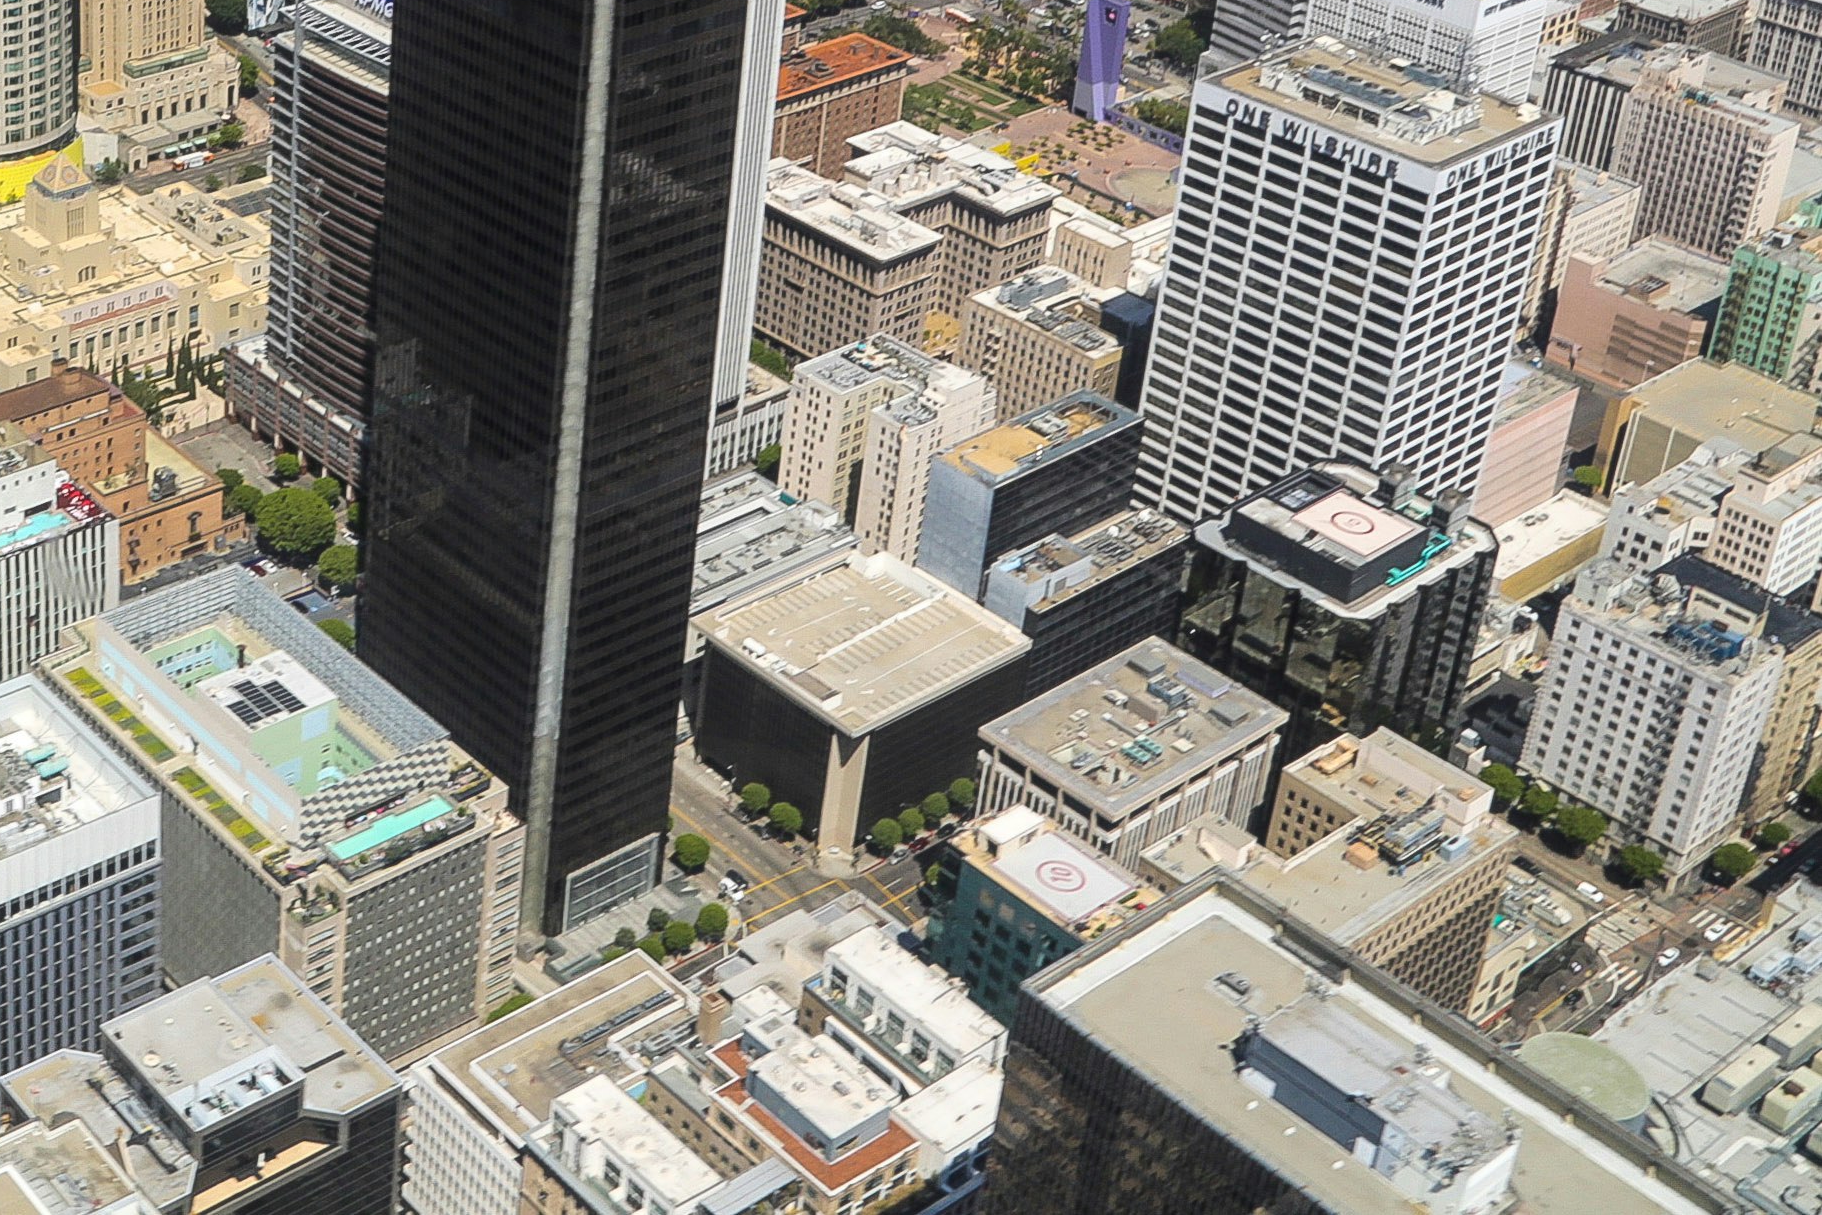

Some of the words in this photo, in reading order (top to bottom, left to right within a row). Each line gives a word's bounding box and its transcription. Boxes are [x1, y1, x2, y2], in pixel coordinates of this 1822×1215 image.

[1226, 98, 1273, 130] ONE
[1281, 118, 1400, 180] WILSHIRE
[1447, 161, 1479, 188] ONE
[1484, 126, 1556, 171] WILSHIRE
